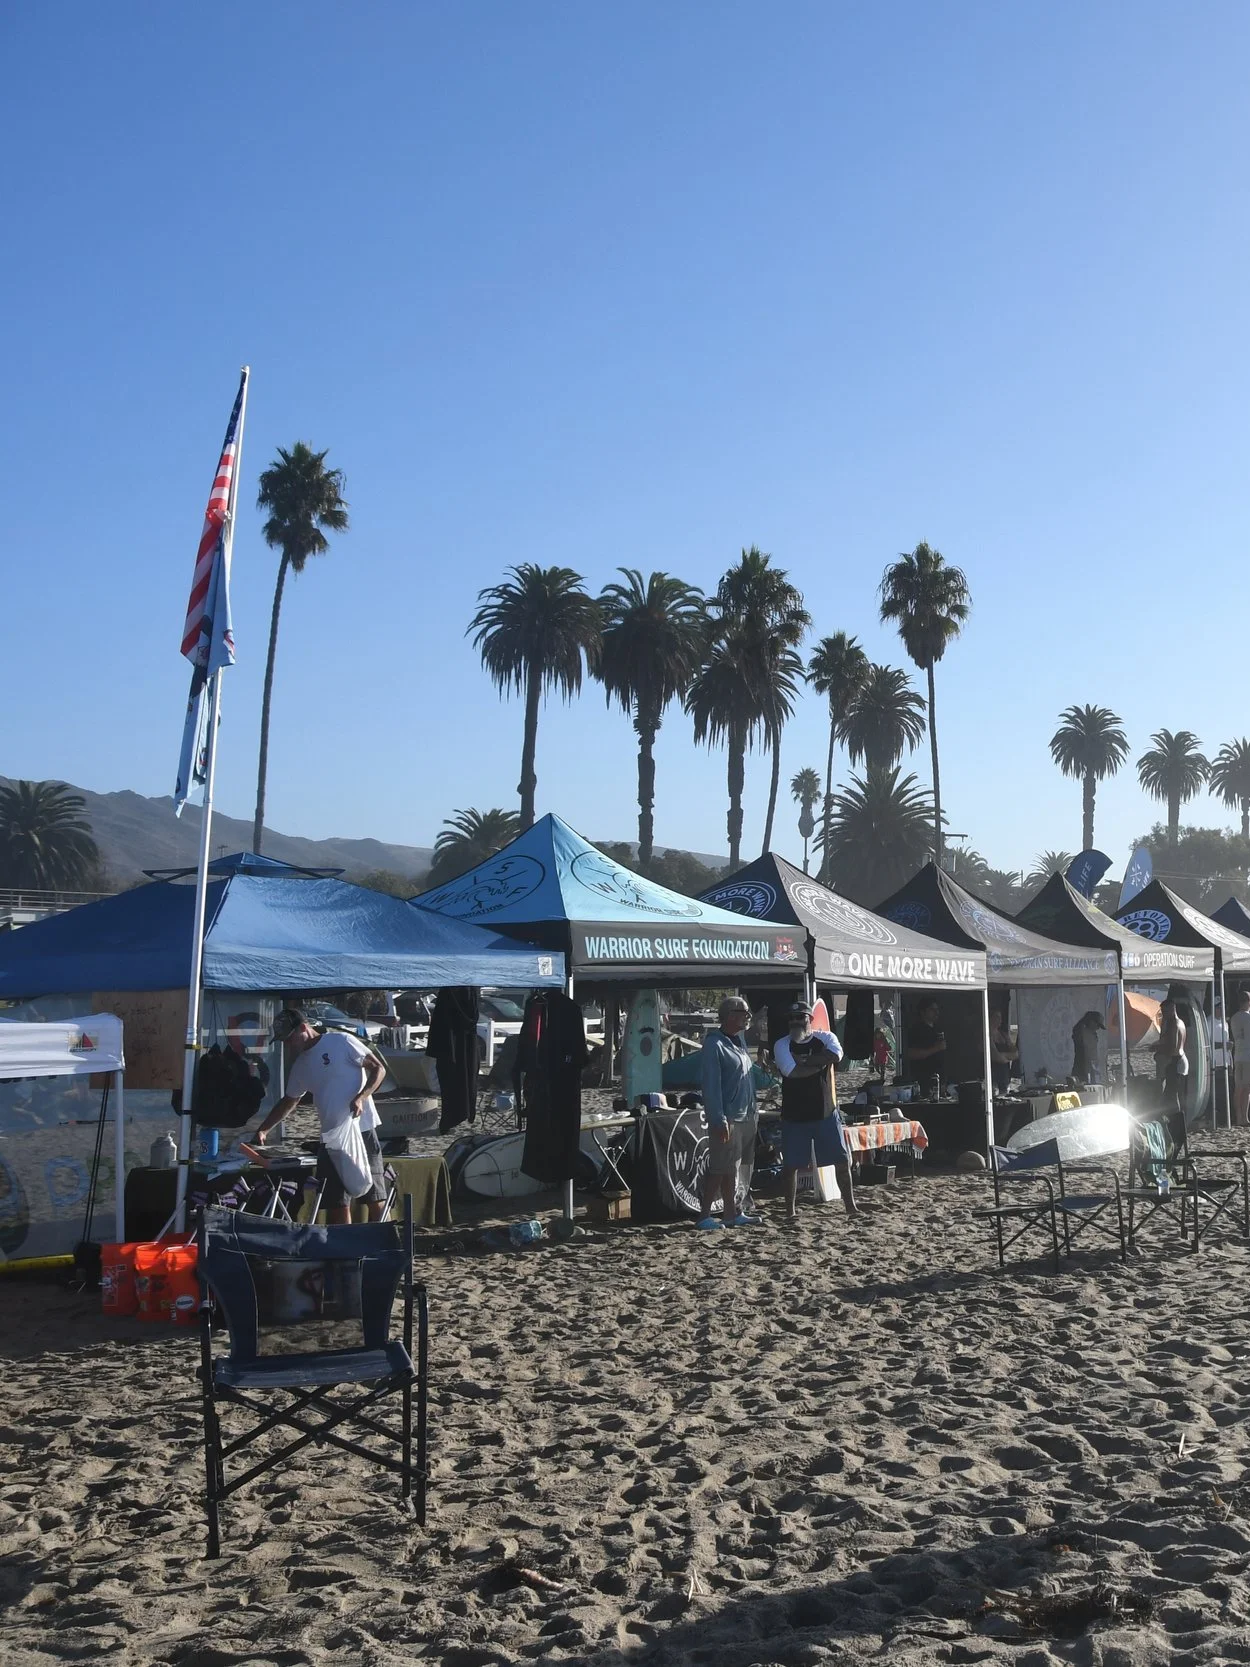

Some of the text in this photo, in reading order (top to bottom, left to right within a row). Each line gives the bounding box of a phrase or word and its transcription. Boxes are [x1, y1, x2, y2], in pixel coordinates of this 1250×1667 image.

[1078, 861, 1092, 889] LIFE
[715, 888, 767, 913] MORE WAVE
[585, 937, 769, 960] WARRIOR SURF FOUNDATION
[849, 953, 975, 982] ONE MORE WAVE
[1044, 957, 1064, 969] SURF
[1064, 957, 1100, 970] ALLIANCE
[1143, 953, 1195, 968] OPERATION SURF
[392, 1113, 427, 1124] CAUTION
[674, 1151, 687, 1171] W
